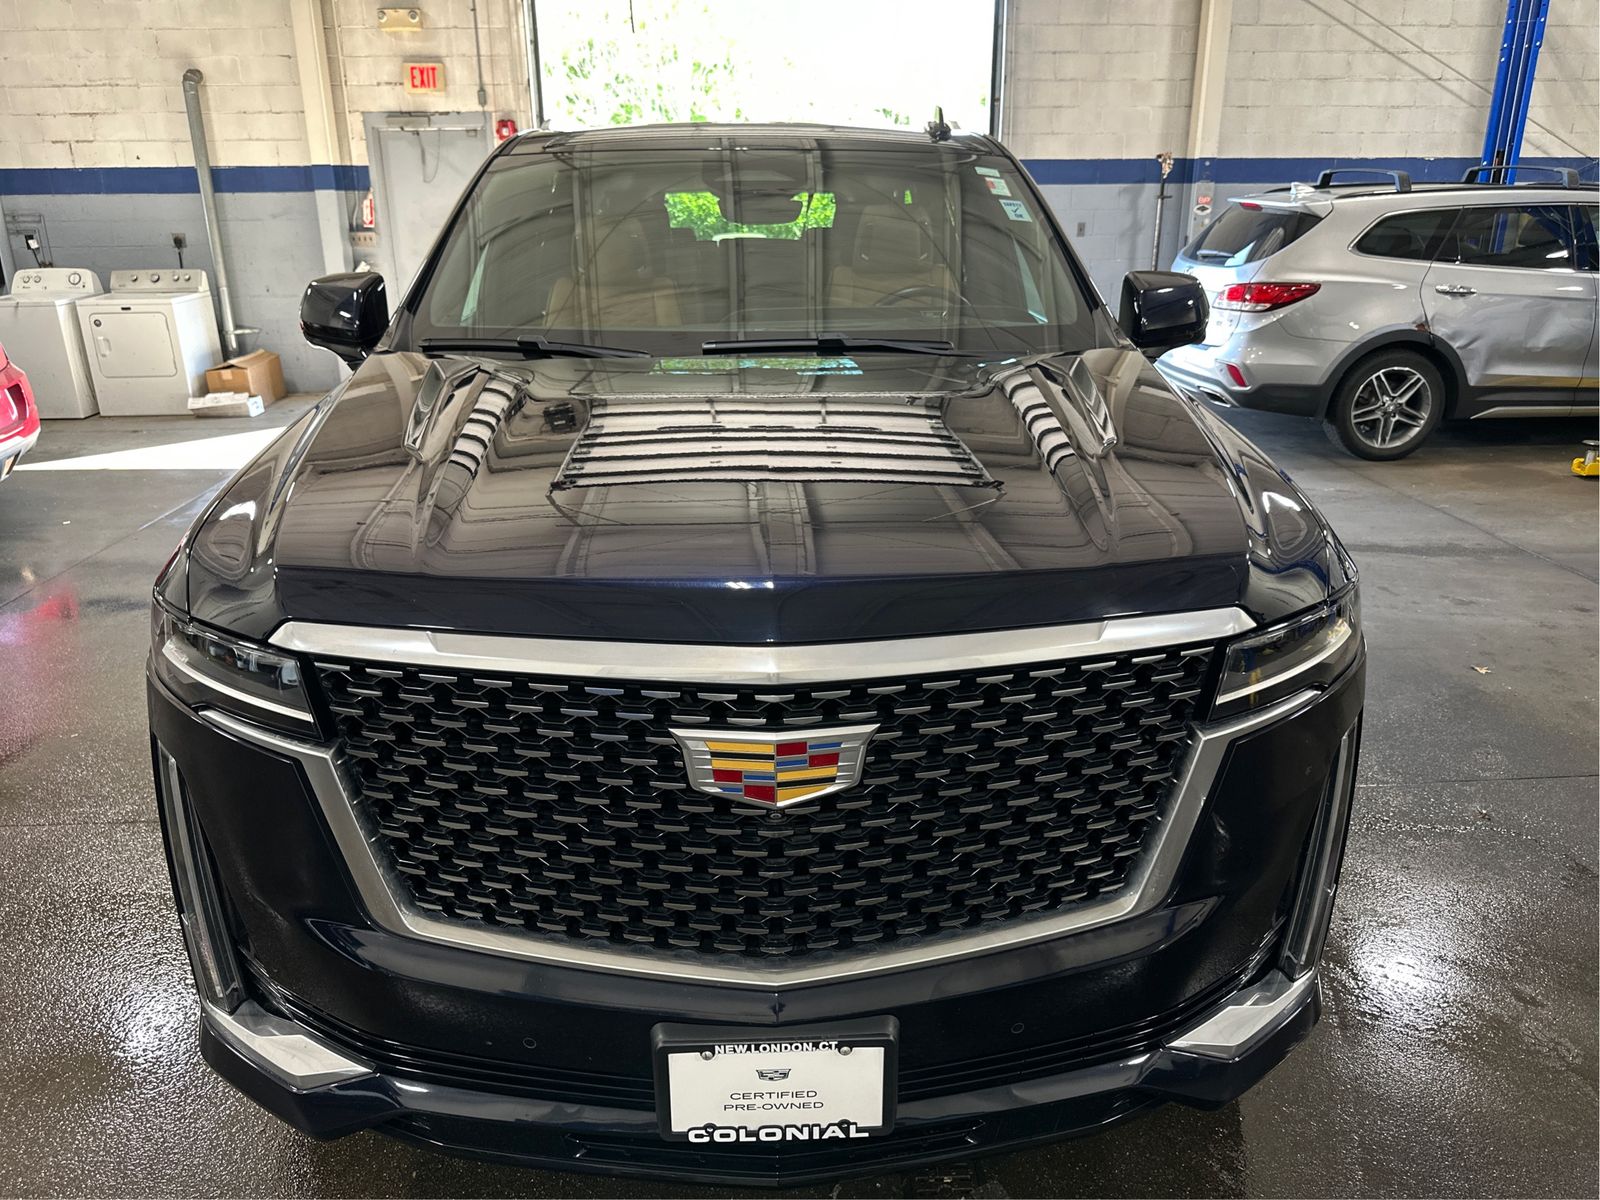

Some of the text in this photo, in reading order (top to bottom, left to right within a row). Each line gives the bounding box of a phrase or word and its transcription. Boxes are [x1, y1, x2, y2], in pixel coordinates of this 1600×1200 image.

[410, 66, 437, 88] EXIT
[714, 1044, 747, 1054] NEW
[730, 1090, 817, 1101] CERTIFIED
[723, 1101, 824, 1111] PRE-OWNED
[688, 1123, 869, 1143] COLONIAL
